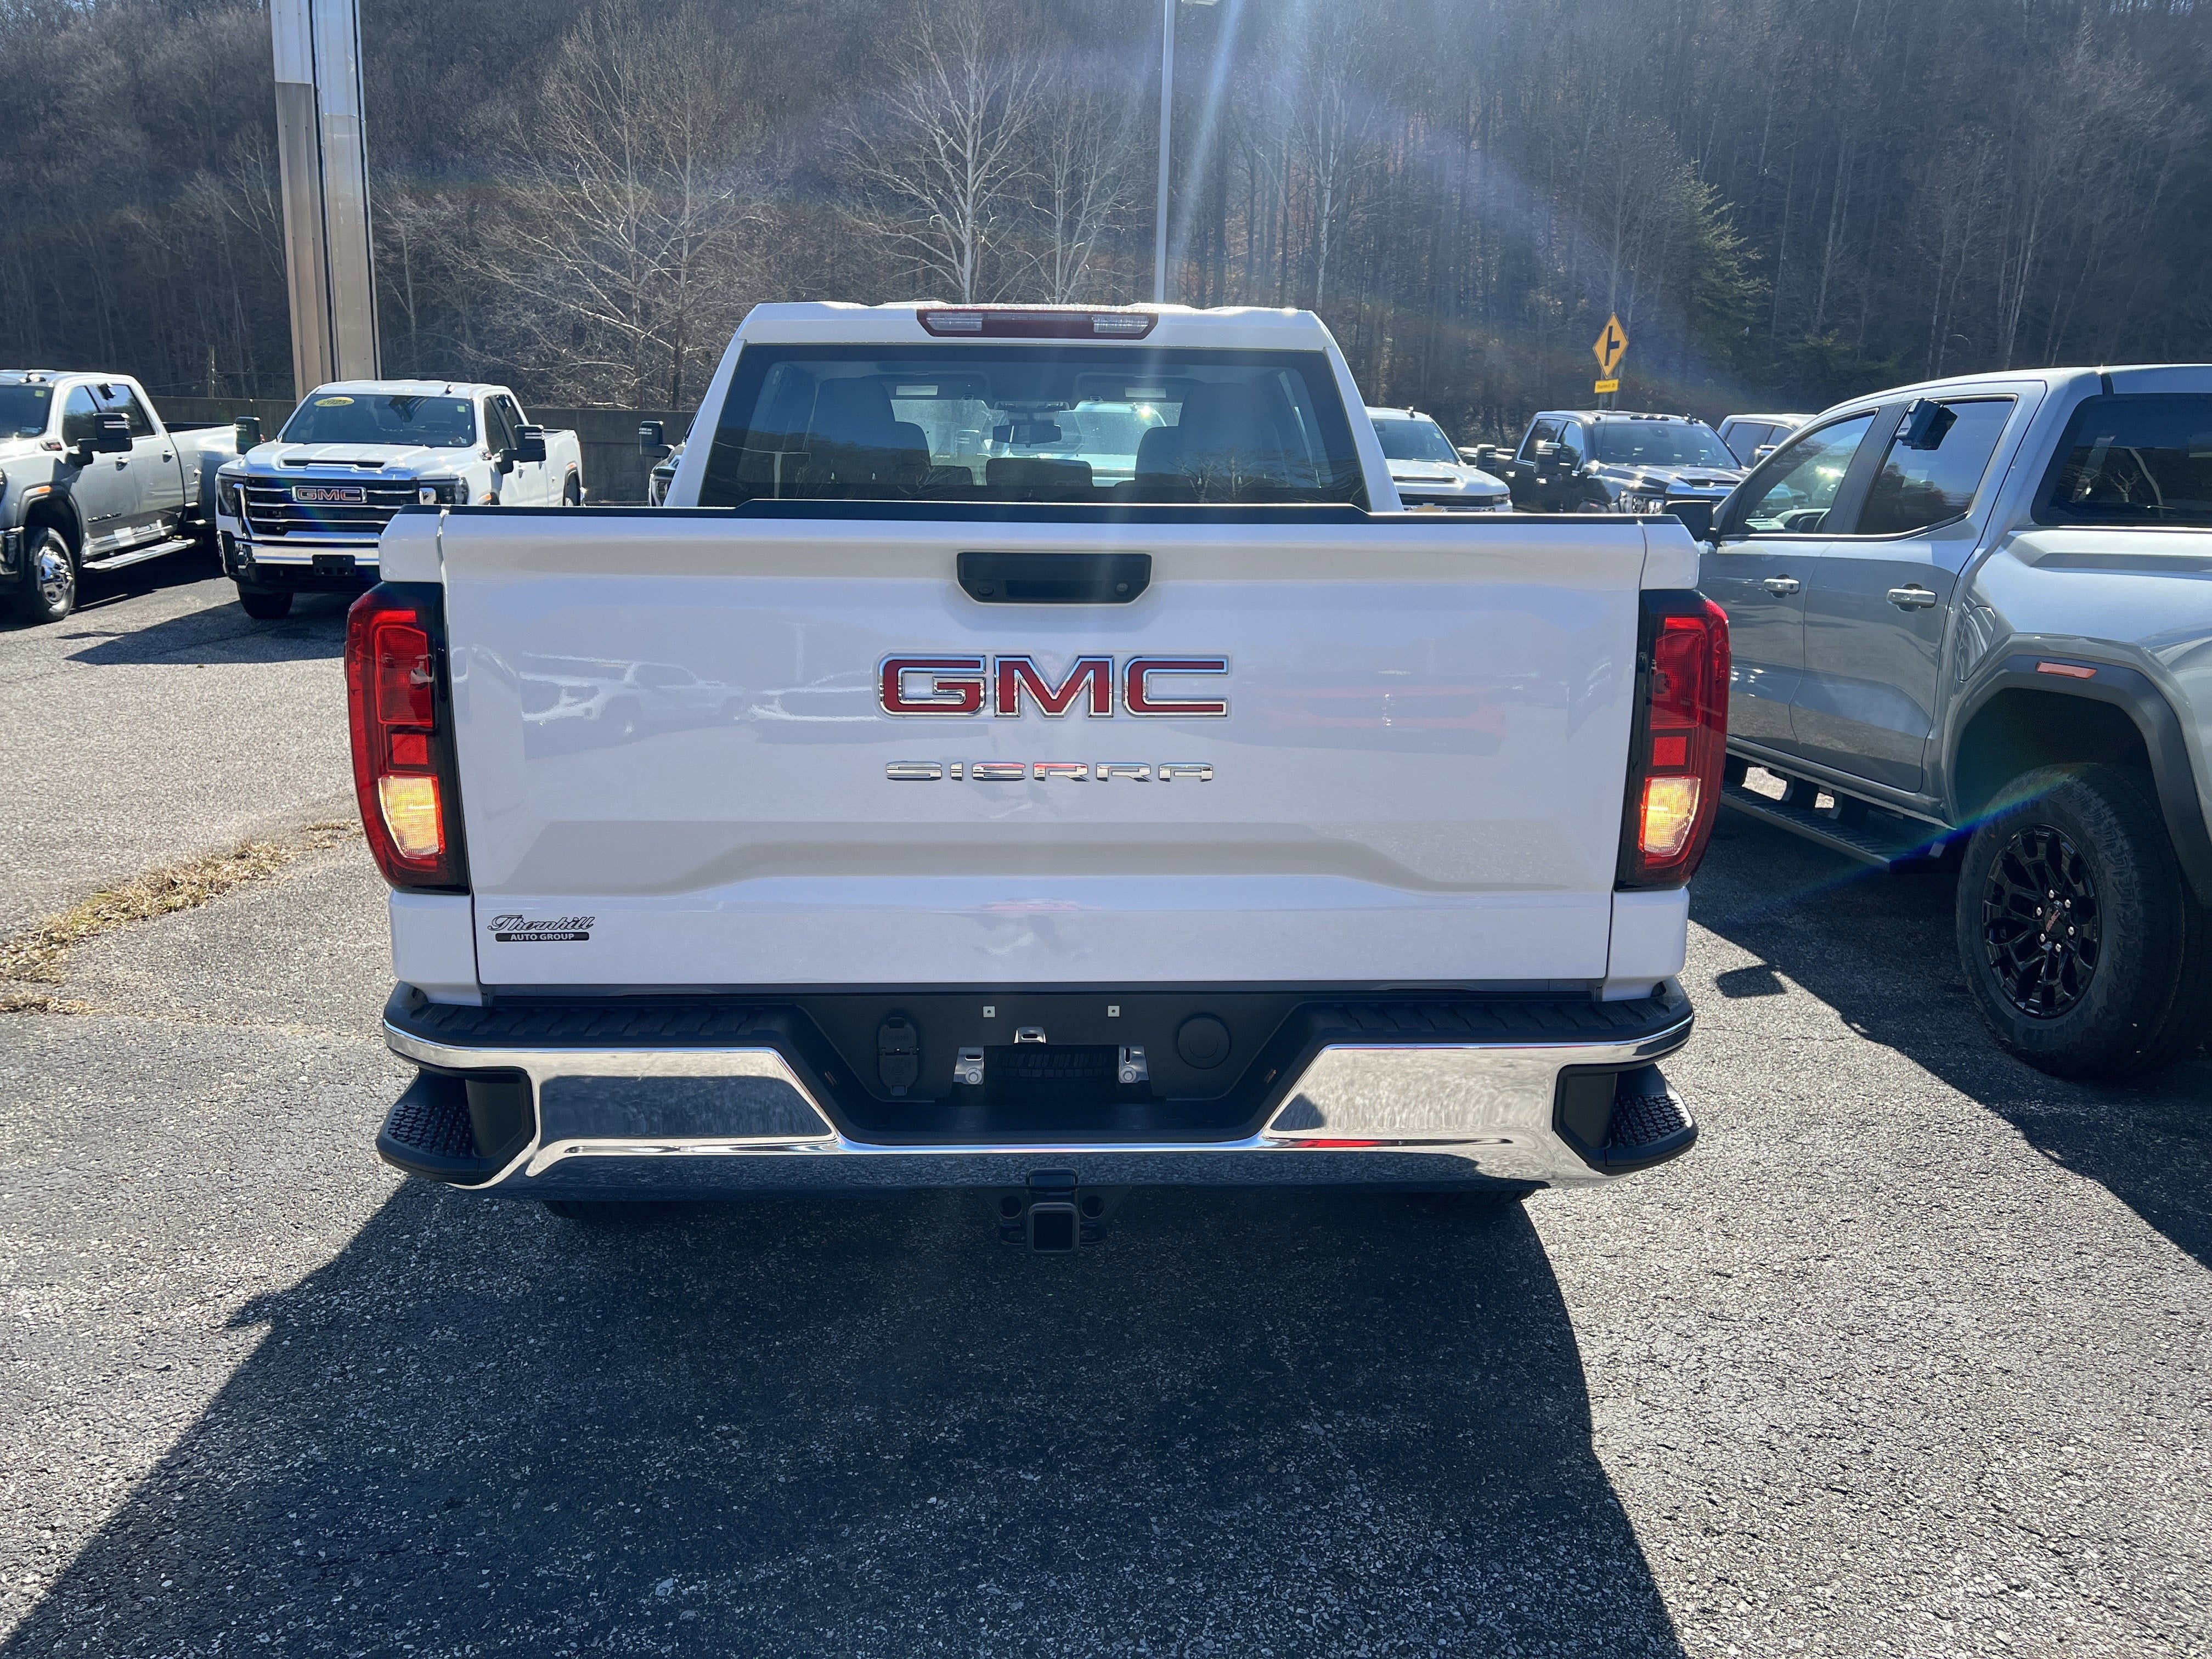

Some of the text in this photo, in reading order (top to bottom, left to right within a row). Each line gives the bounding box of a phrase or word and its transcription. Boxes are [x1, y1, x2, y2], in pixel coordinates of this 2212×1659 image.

[297, 488, 361, 501] GMC
[879, 655, 1228, 718] GMC
[887, 761, 1213, 782] SIERRA
[487, 915, 595, 931] Thornhill
